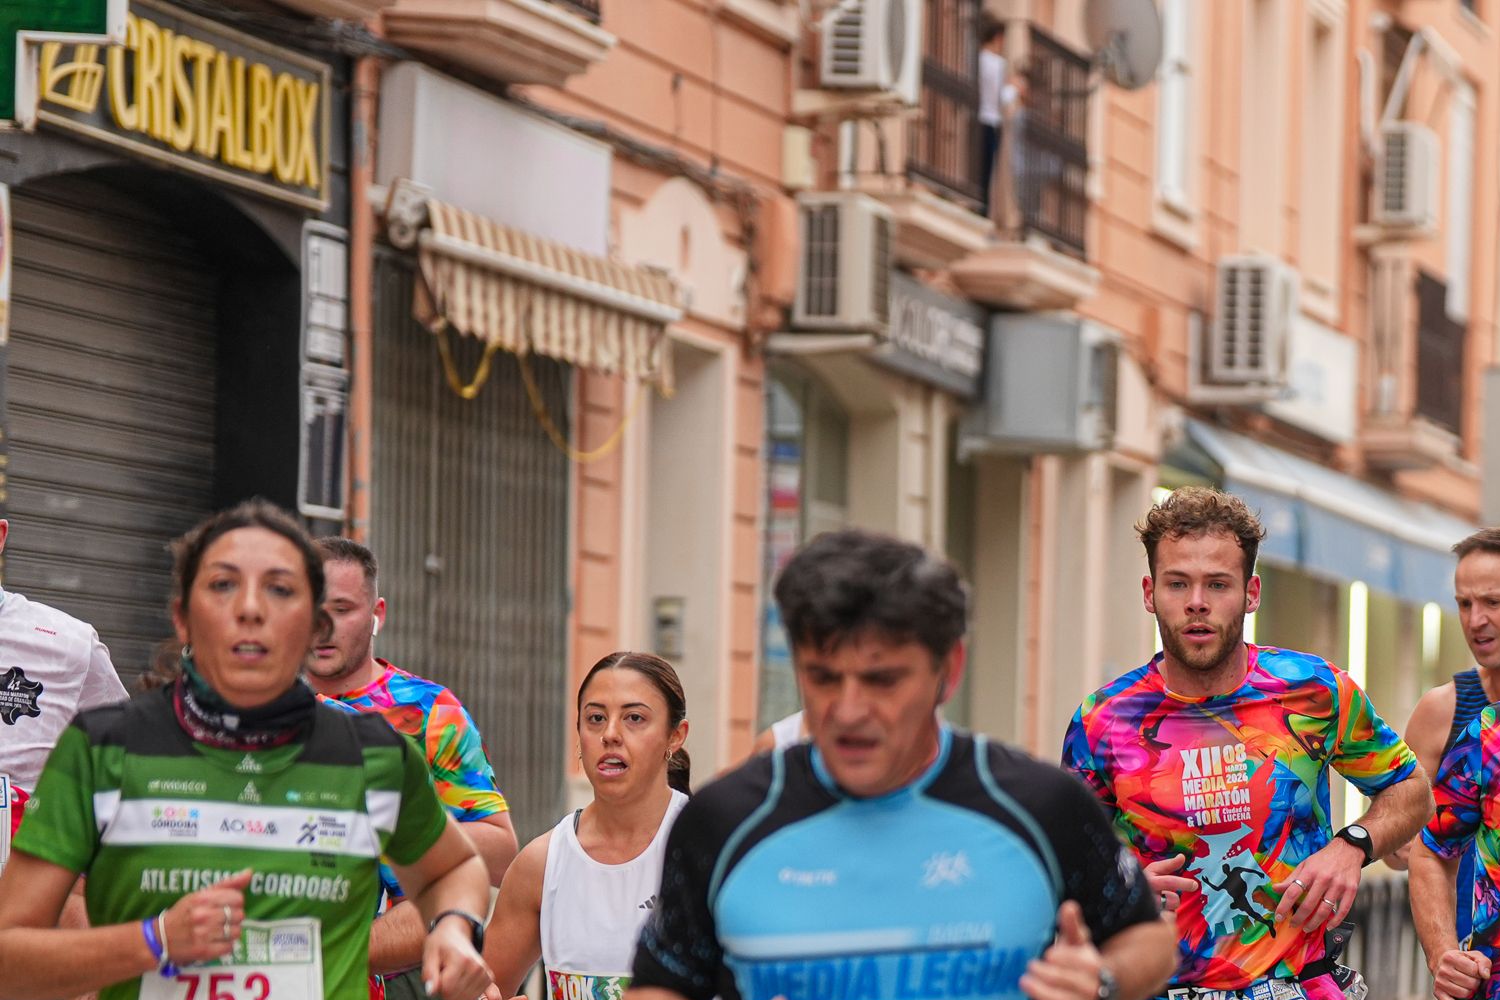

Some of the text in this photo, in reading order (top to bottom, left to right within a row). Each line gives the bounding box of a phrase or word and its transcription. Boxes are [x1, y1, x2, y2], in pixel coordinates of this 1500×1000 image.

[107, 11, 320, 188] CRISTALBOX
[1180, 743, 1247, 779] XII 08
[1225, 764, 1248, 772] MARZO
[1182, 776, 1226, 795] MEDIA
[1226, 773, 1249, 783] 2026
[1184, 786, 1251, 811] MARATÓN
[1195, 809, 1221, 826] 10K
[1223, 812, 1251, 822] LUCENA
[140, 868, 350, 901] ATLETISM CORDOBÉS
